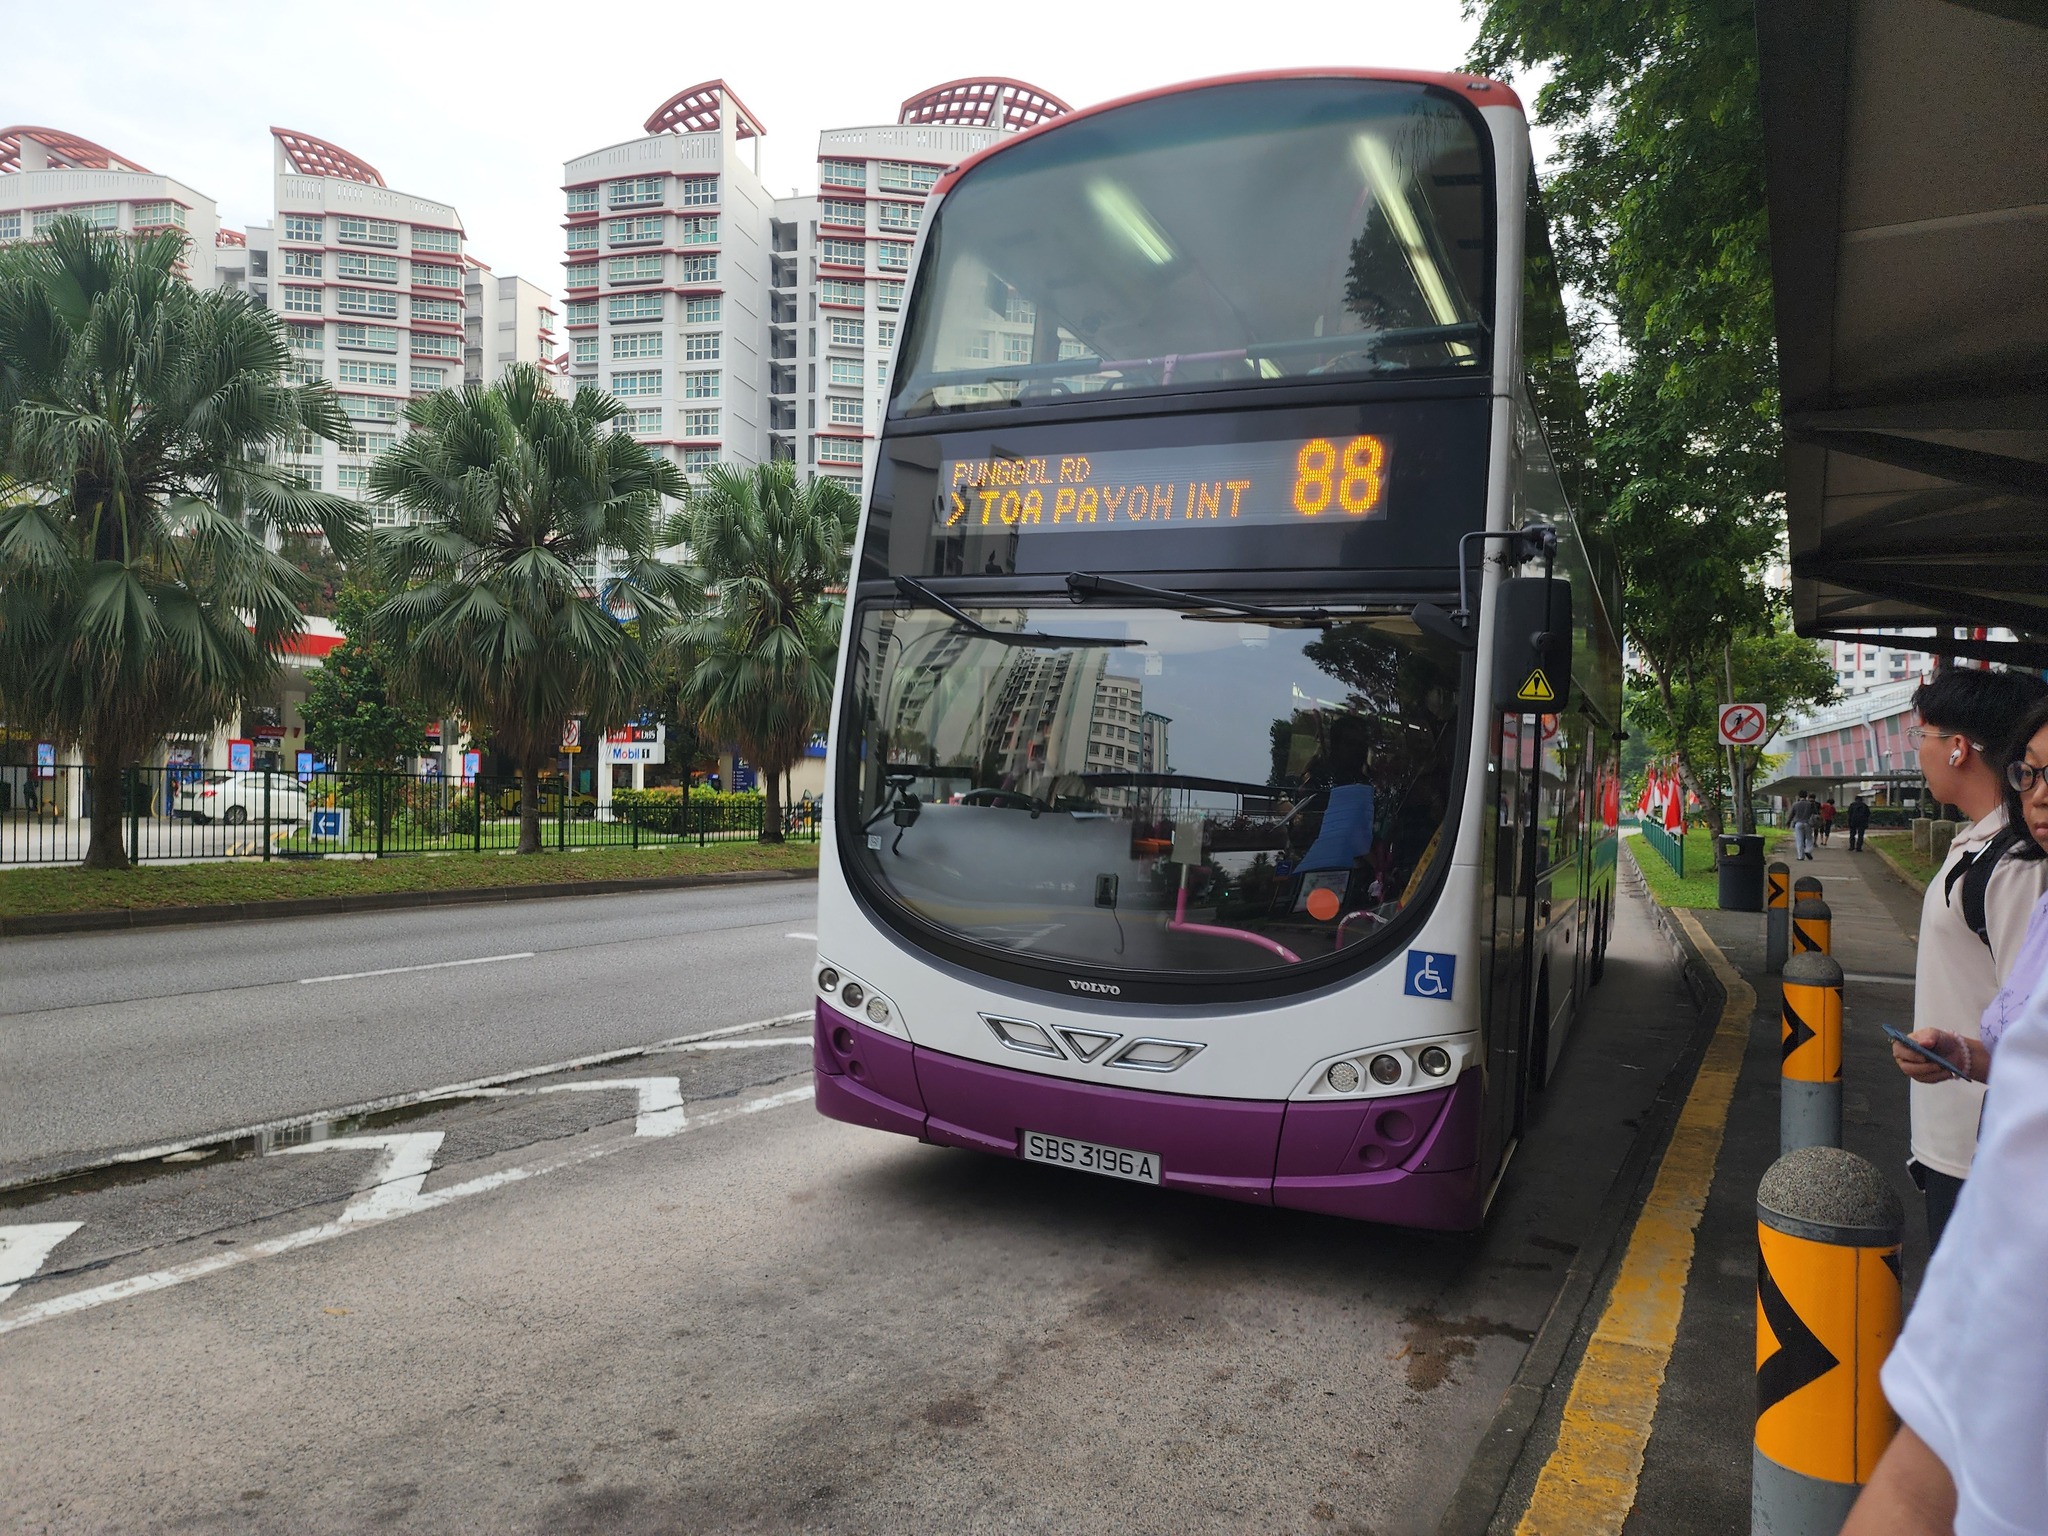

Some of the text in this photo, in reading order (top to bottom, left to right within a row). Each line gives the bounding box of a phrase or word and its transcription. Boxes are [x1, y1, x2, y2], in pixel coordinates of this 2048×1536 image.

[953, 457, 1091, 487] PUNGGOL RD
[1293, 435, 1383, 515] 88
[979, 480, 1250, 525] TOA PAYOH INT
[613, 748, 640, 760] Mobil
[1068, 979, 1121, 996] VOLVO
